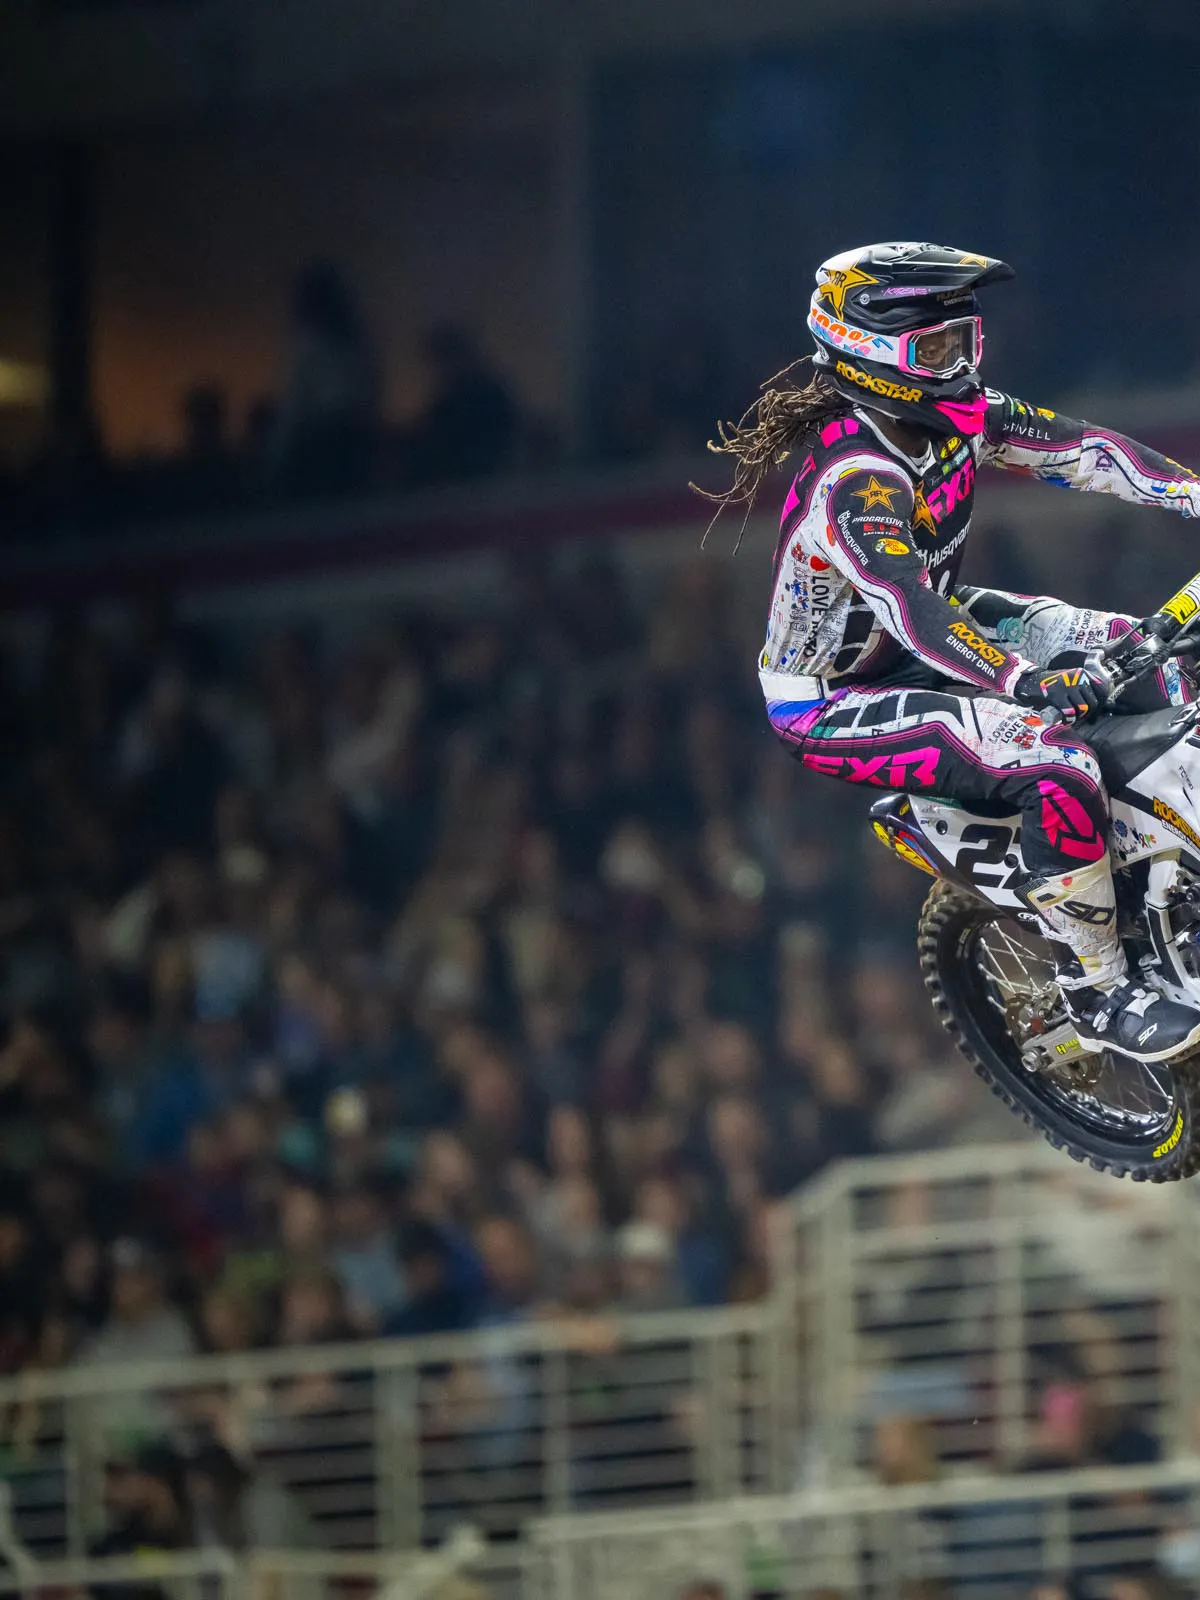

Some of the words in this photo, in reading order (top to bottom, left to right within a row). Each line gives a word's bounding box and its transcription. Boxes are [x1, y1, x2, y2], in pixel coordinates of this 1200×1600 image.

[836, 360, 923, 402] ROCKSTAR
[852, 515, 905, 528] PROGRESSIVE
[840, 520, 868, 567] Husqvarna
[811, 576, 830, 617] LOVE
[945, 634, 978, 662] ENERGY
[1001, 721, 1022, 744] LOVE
[803, 746, 941, 787] FXR
[1153, 1111, 1184, 1158] DUNLOP
